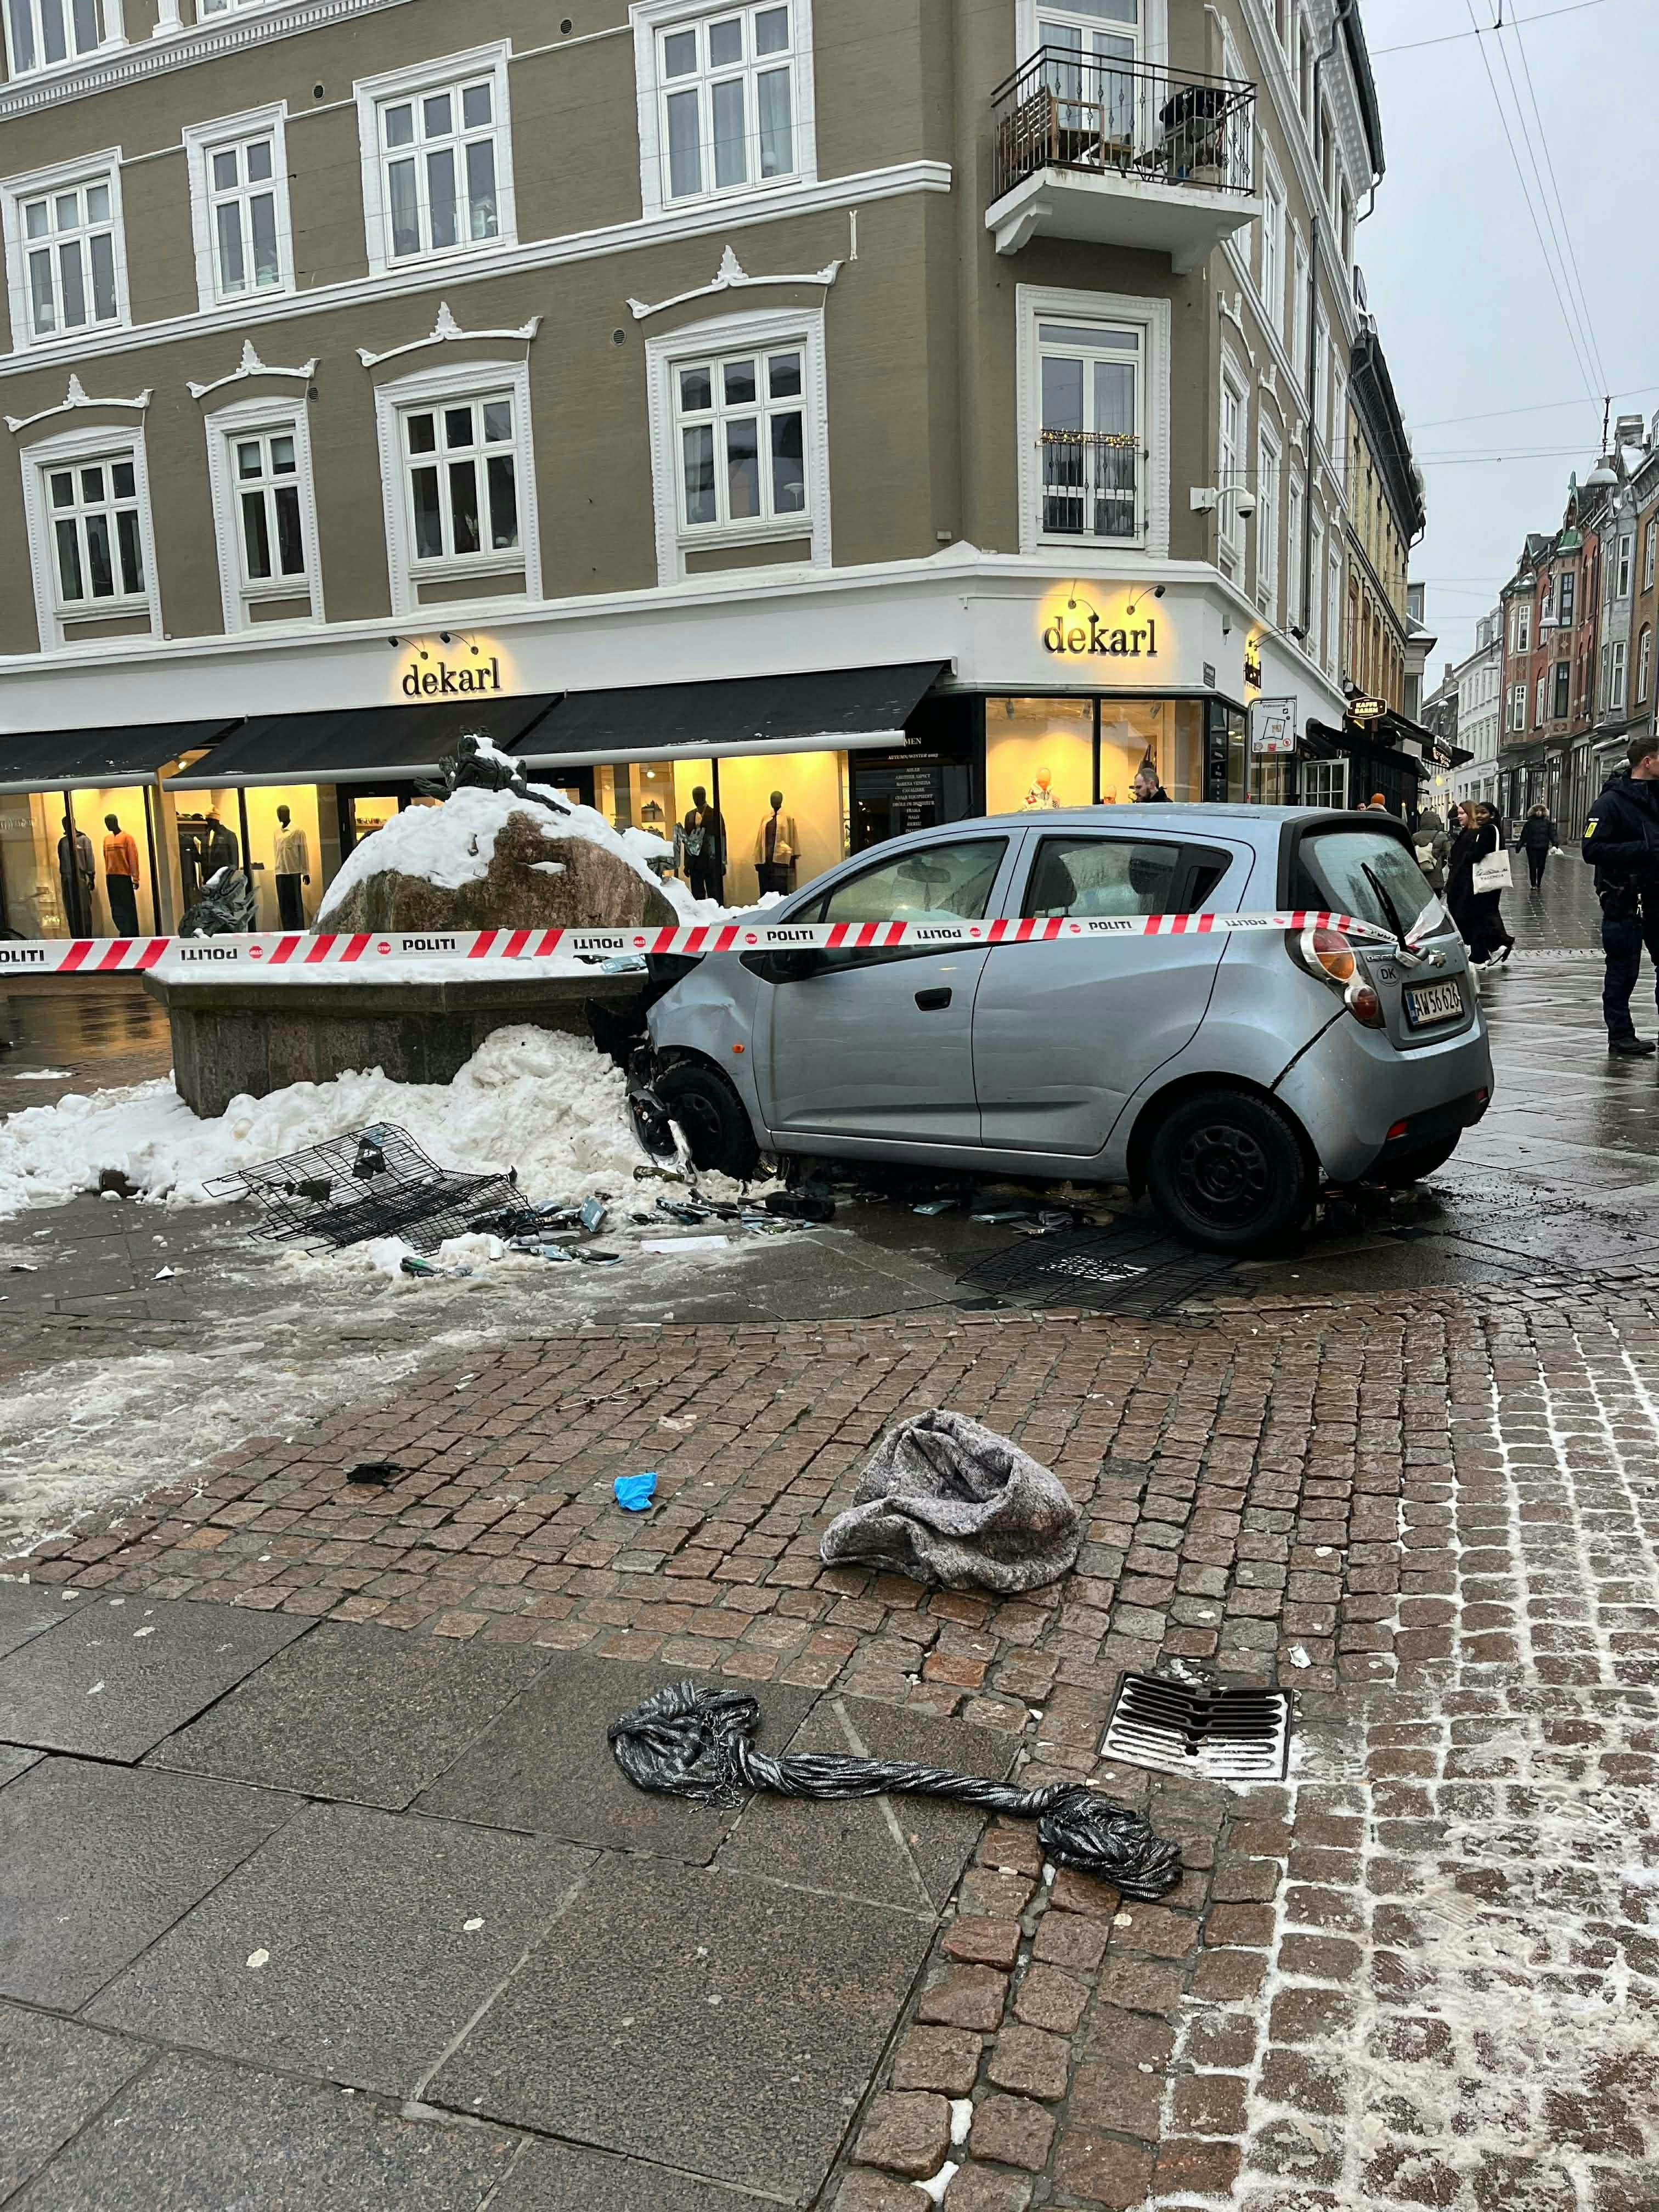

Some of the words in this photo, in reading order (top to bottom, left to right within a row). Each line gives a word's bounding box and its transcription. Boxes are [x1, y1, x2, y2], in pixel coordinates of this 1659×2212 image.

[1044, 616, 1158, 654] dekarl
[402, 657, 500, 696] dekarl
[1088, 921, 1132, 930] POLITI
[767, 930, 814, 941] POLITI
[917, 929, 962, 939] POLITI
[403, 939, 456, 950] POLITI
[573, 938, 624, 949] POLITI
[0, 950, 44, 962] OLITI
[181, 948, 238, 961] POLITI
[1380, 968, 1396, 979] DK
[1414, 993, 1431, 1017] AW
[1429, 990, 1442, 1013] 56
[1442, 986, 1459, 1009] 626
